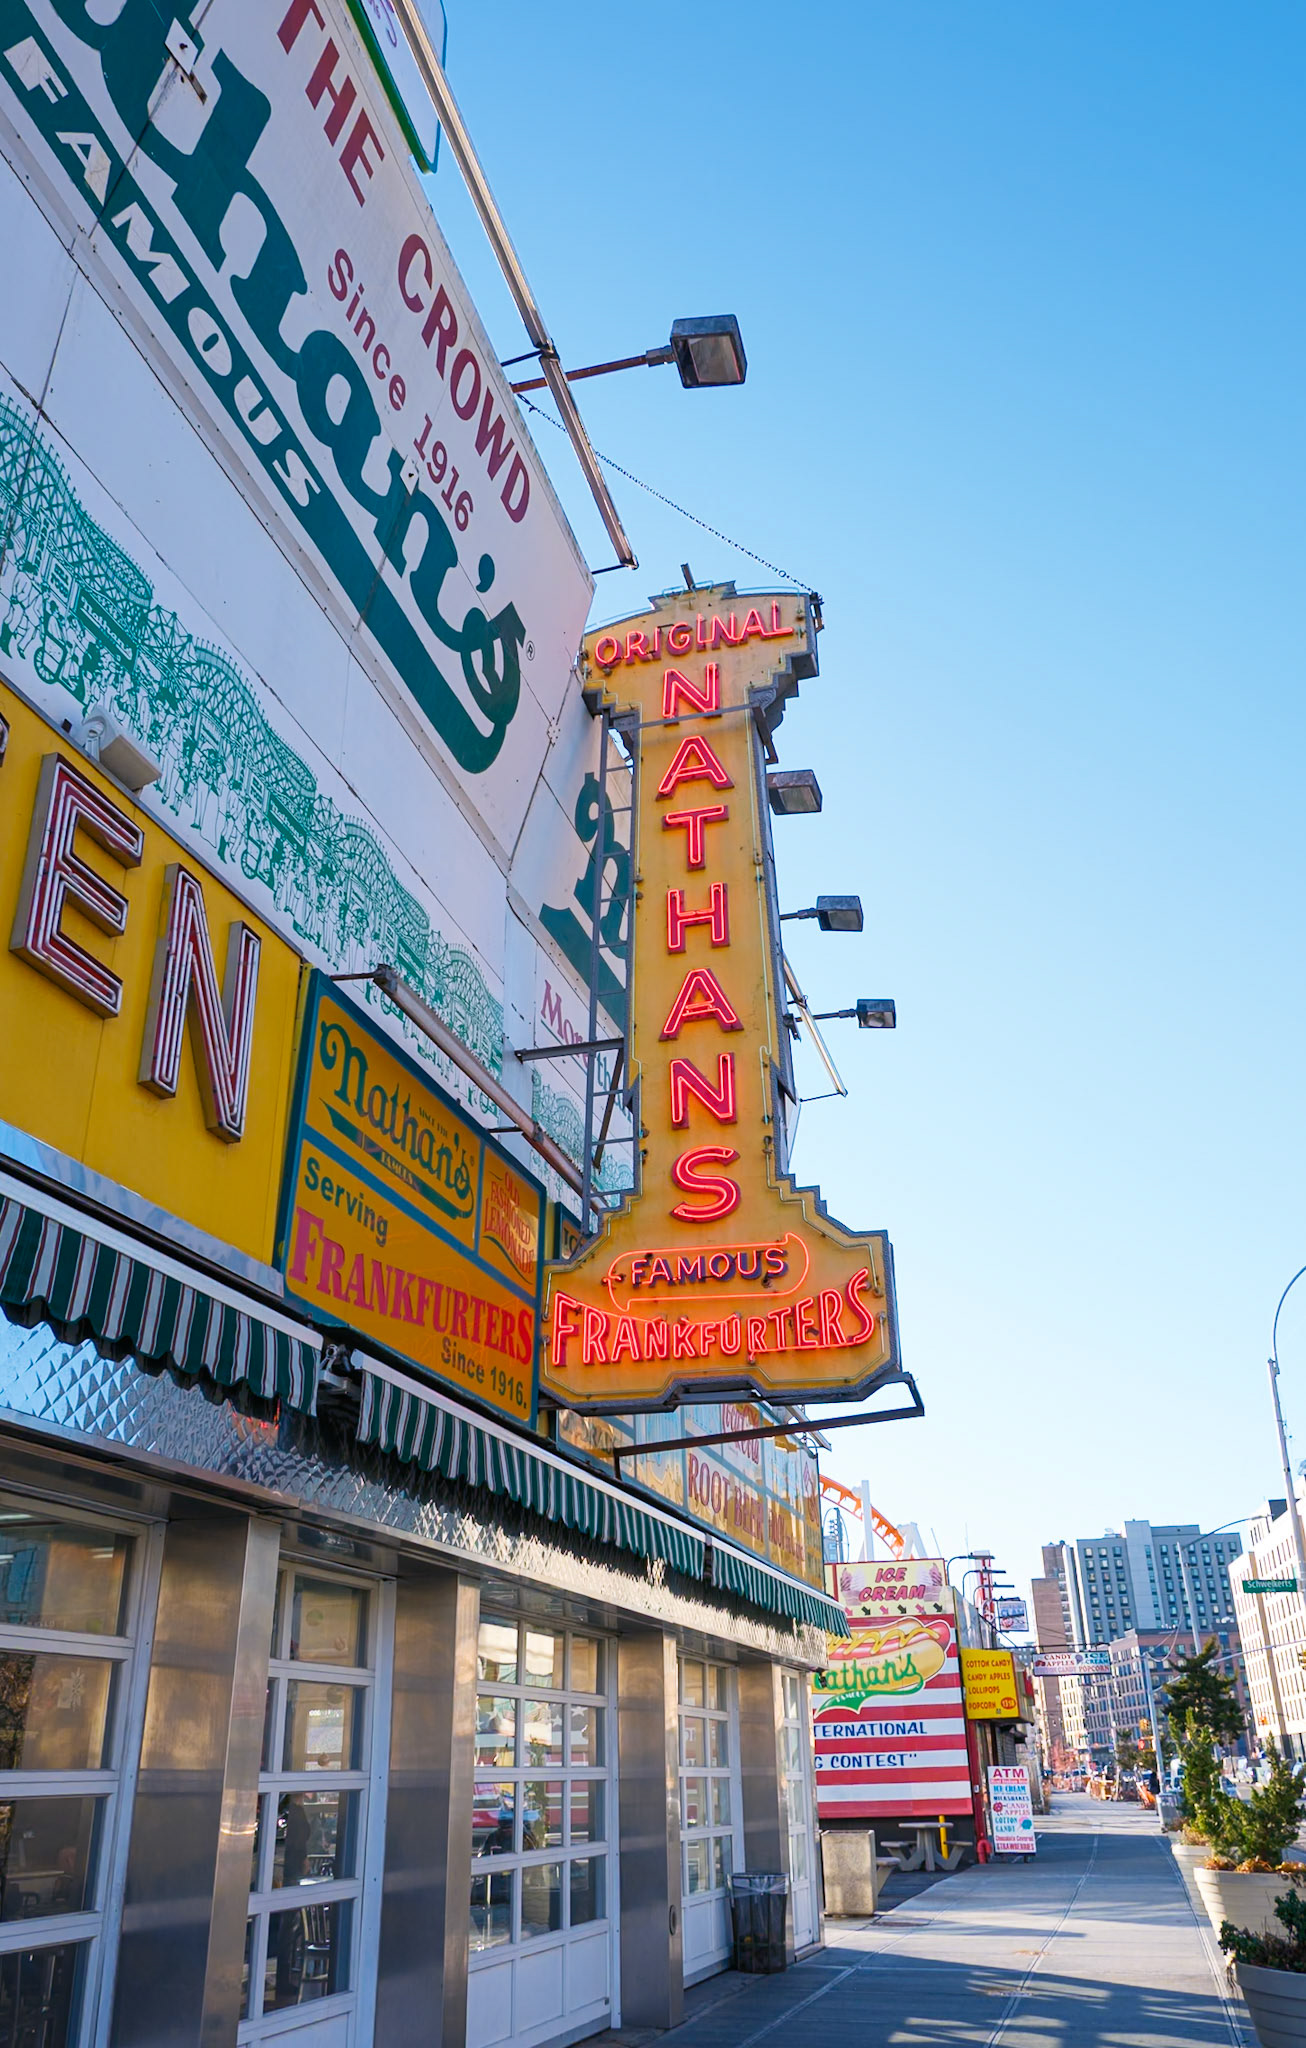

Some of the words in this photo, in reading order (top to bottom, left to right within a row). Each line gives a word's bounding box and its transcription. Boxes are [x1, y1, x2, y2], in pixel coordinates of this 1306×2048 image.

[3, 35, 321, 507] FAMOUS
[277, 0, 385, 207] THE
[397, 233, 531, 523] CROWD
[327, 248, 408, 412] Since
[413, 413, 475, 532] 1916
[594, 600, 794, 668] ORIGINAL
[656, 662, 744, 1223] NATHANS
[320, 1020, 473, 1200] Nathan's
[304, 1156, 389, 1248] Serving
[484, 1196, 535, 1274] LEMONADE
[289, 1205, 534, 1366] FRANKFURTERS
[630, 1246, 790, 1290] FAMOUS
[551, 1267, 875, 1367] FRANKFURTERS
[441, 1335, 485, 1385] Since
[490, 1365, 528, 1410] 1916.
[688, 1452, 731, 1521] ROOT
[858, 1584, 927, 1603] CREAM
[874, 1566, 908, 1584] ICE
[1247, 1580, 1293, 1589] Schweikerts
[966, 1660, 990, 1668] COTTON
[991, 1659, 1011, 1667] CANDY
[967, 1673, 987, 1681] CANDY
[989, 1672, 1011, 1680] APPLES
[968, 1685, 1000, 1695] LOLLIPOPS
[968, 1701, 997, 1710] POPCORN
[993, 1768, 1025, 1778] ATM
[995, 1816, 1018, 1824] COTTON
